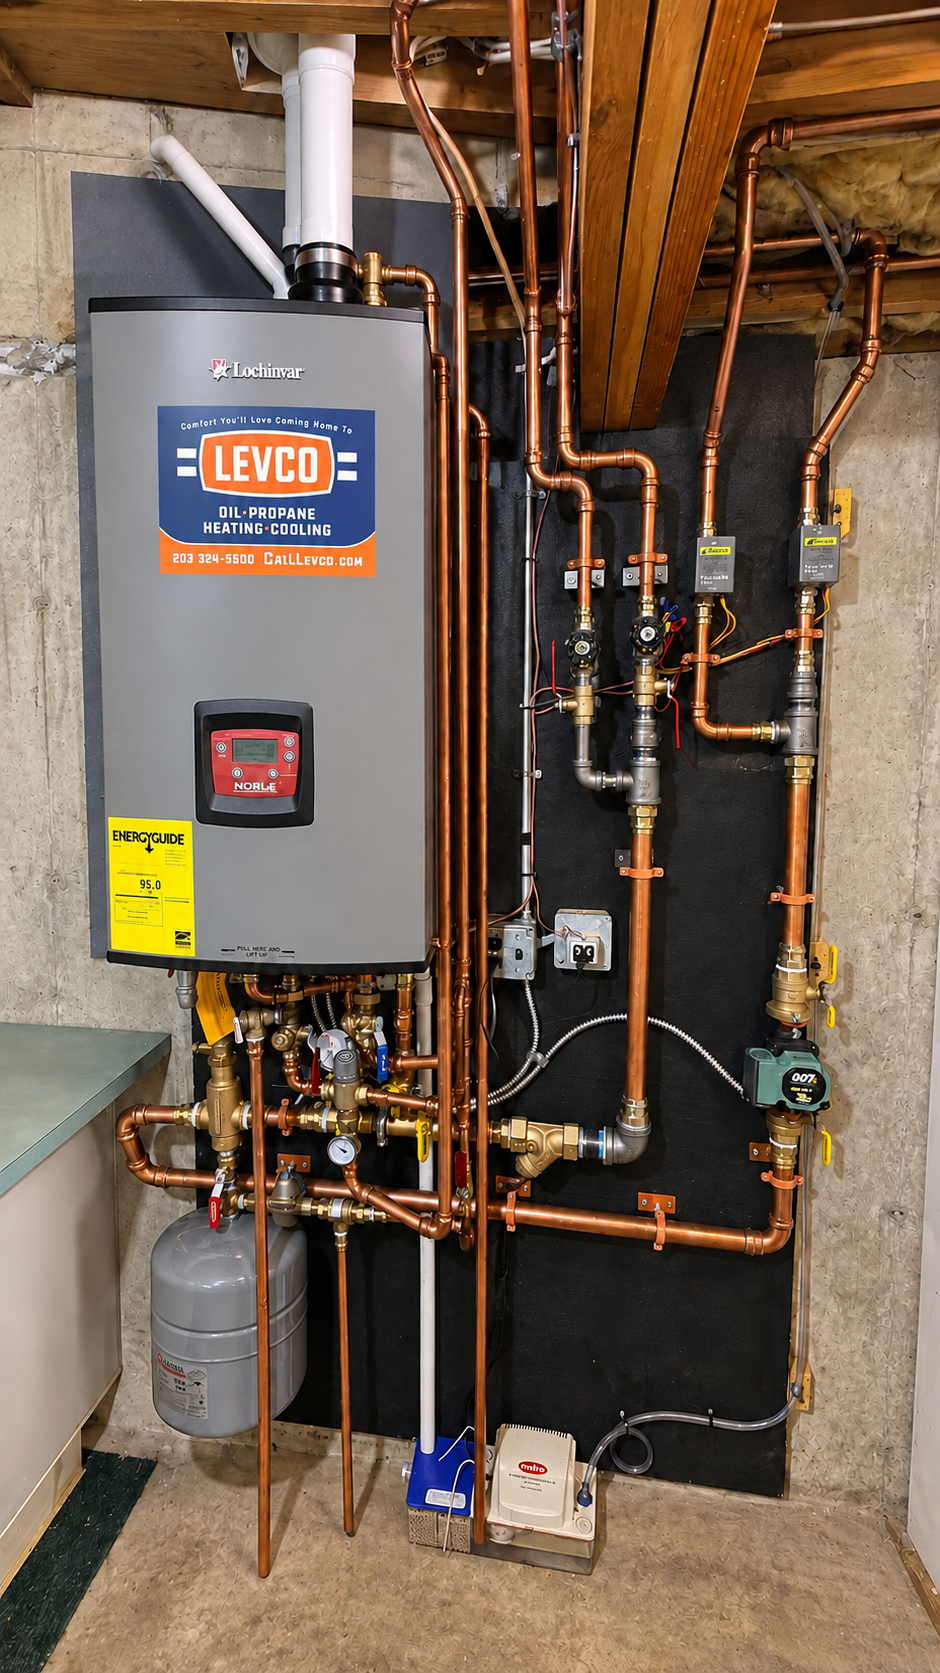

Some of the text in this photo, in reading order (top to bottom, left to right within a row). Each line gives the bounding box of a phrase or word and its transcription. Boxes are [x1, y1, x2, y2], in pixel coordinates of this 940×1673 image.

[232, 361, 305, 380] Lochinvar
[180, 416, 353, 435] Comfort You'll Love Coming Home To
[215, 445, 318, 484] LEVCO
[172, 552, 194, 564] 203
[198, 553, 255, 565] 324-5500
[140, 879, 161, 890] 95.0
